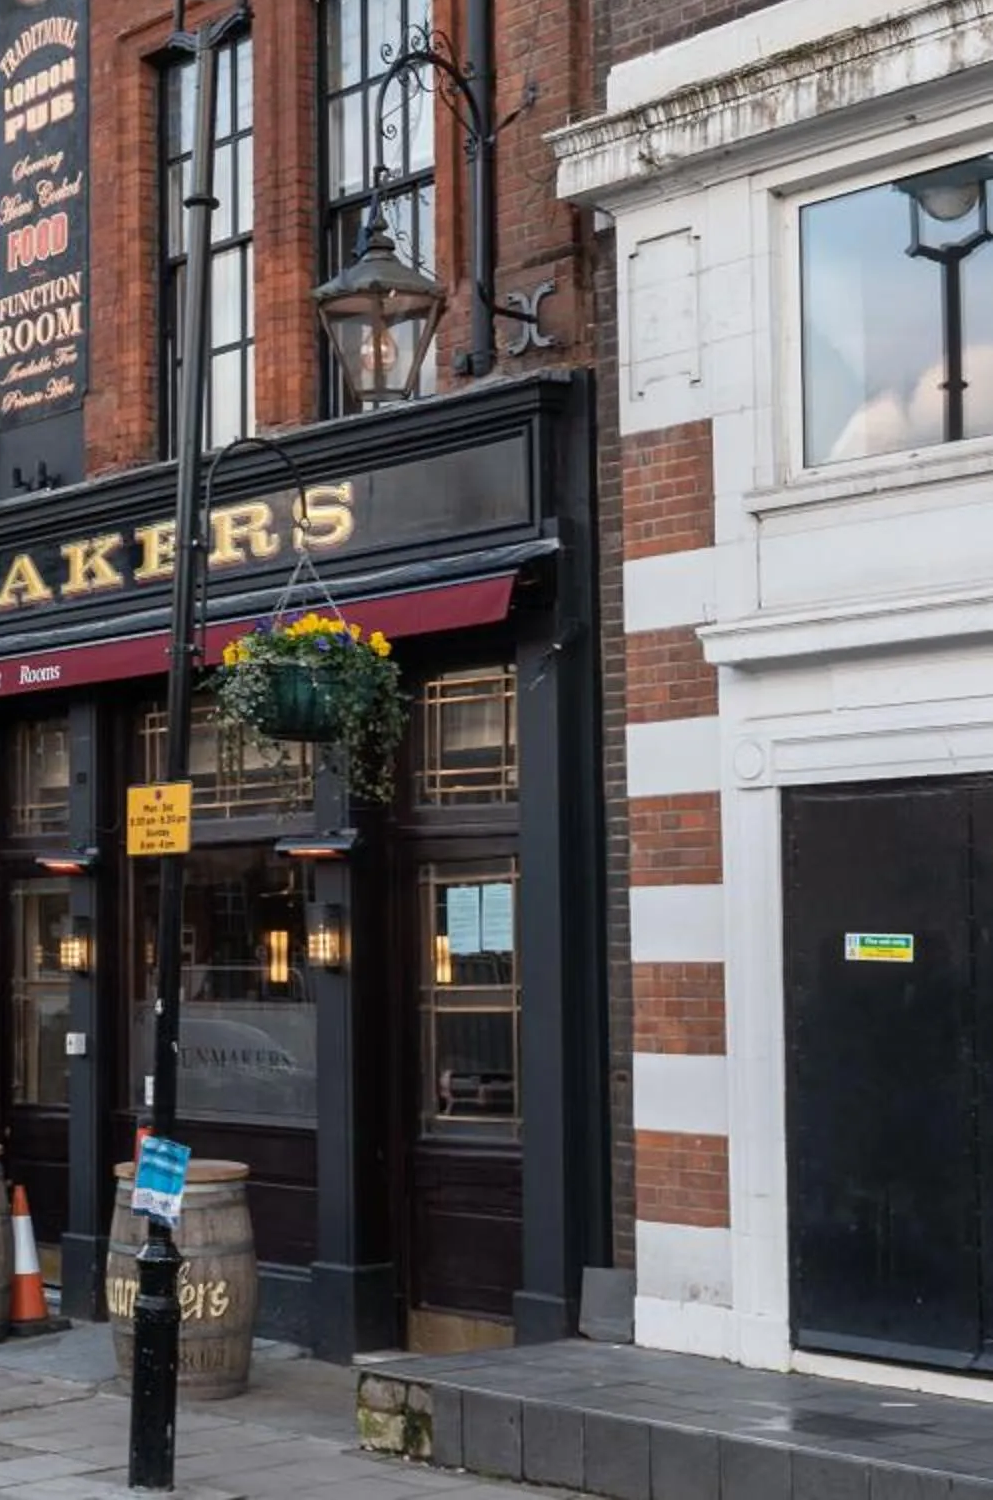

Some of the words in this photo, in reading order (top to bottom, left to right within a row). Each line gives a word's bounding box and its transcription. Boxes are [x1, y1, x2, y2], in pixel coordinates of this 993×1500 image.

[0, 17, 78, 79] TRADITIONAL
[4, 56, 75, 112] LONDON
[4, 91, 75, 144] PUB
[7, 212, 68, 272] FOOD
[19, 664, 61, 685] Rooms
